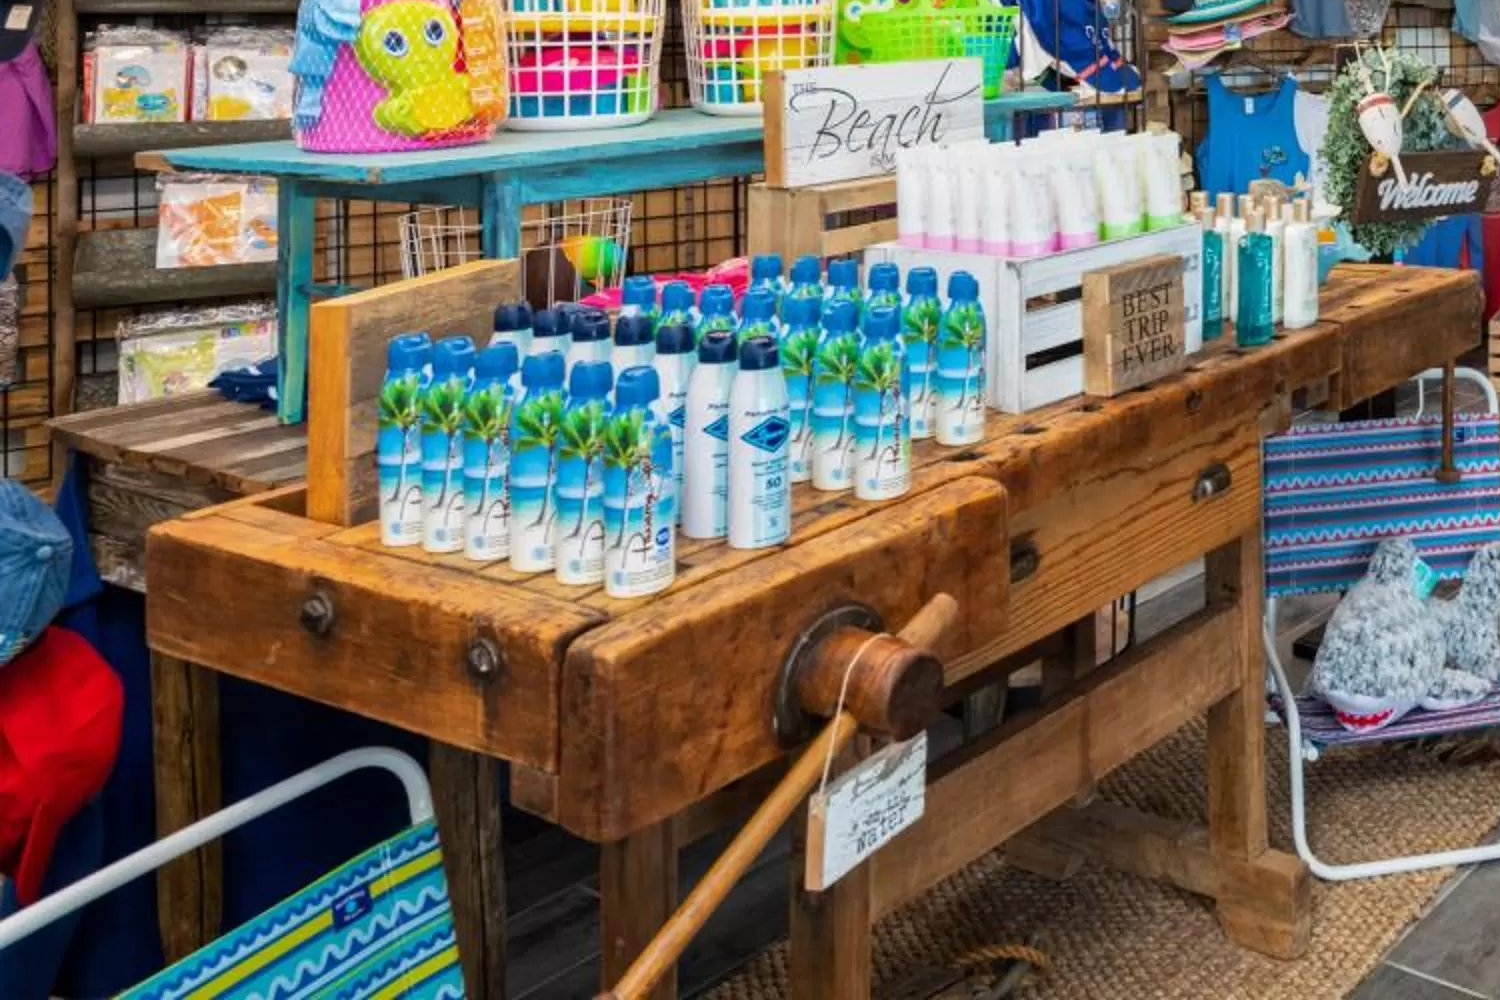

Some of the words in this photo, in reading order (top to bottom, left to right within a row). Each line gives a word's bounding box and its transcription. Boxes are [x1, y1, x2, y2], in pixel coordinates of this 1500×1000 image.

[789, 61, 980, 168] Beach
[1377, 171, 1480, 211] Welcome
[1122, 281, 1173, 317] BEST
[1123, 309, 1169, 344] TRIP
[1121, 333, 1177, 372] EVER
